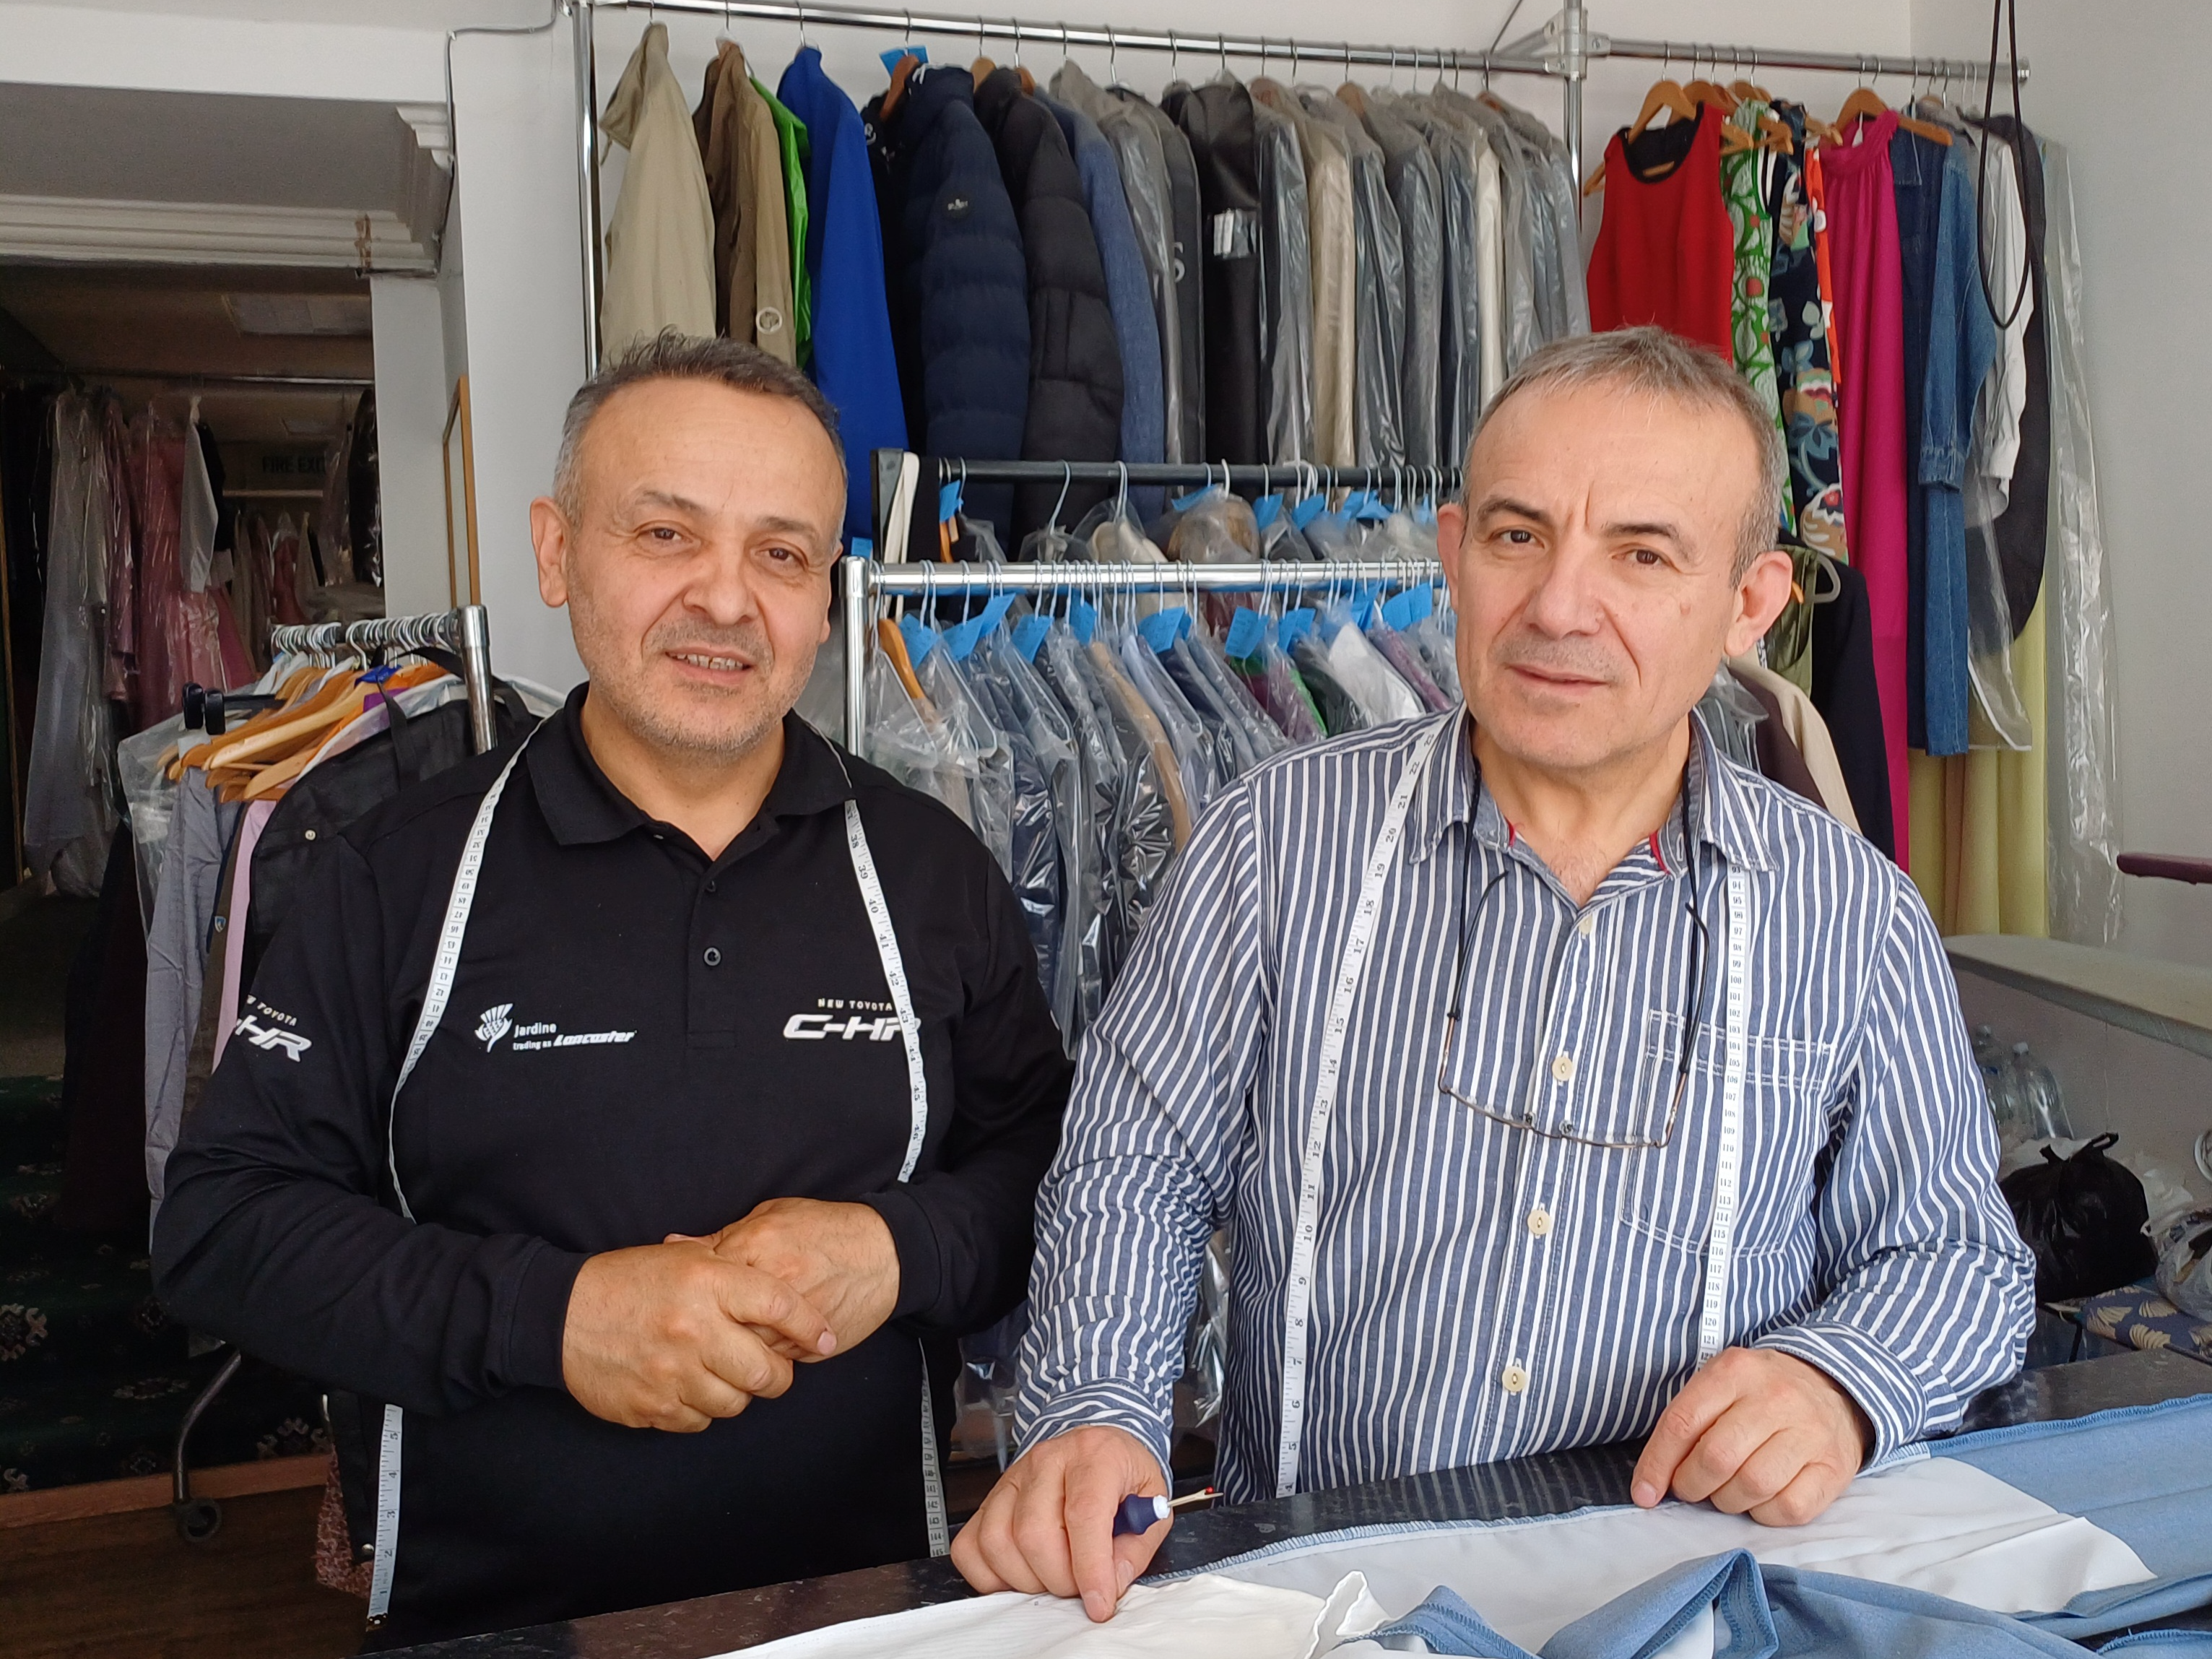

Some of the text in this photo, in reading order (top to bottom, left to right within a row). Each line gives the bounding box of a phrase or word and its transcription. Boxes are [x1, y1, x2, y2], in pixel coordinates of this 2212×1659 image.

[1397, 794, 1408, 810] 21
[1386, 828, 1397, 843] 20
[851, 834, 859, 849] 38
[858, 865, 869, 880] 39
[1374, 863, 1385, 878] 19
[1363, 899, 1374, 915] 18
[1353, 937, 1364, 954] 17
[1730, 974, 1742, 984] 100
[1344, 976, 1354, 994] 16
[1730, 992, 1740, 1001] 101
[817, 998, 893, 1011] NEW TOYOTA
[257, 1002, 297, 1026] TOYOTA
[1729, 1008, 1740, 1018] 102
[514, 1023, 557, 1038] Jardine
[1335, 1018, 1345, 1034] 15
[1729, 1025, 1740, 1034] 103
[513, 1041, 541, 1050] trading
[553, 1031, 636, 1047] Lancaster
[1328, 1059, 1337, 1075] 14
[1729, 1058, 1740, 1067] 105
[1727, 1075, 1738, 1083] 106
[1726, 1092, 1736, 1101] 107
[1319, 1099, 1328, 1116] 13
[1725, 1109, 1735, 1118] 108
[1724, 1126, 1735, 1135] 109
[1312, 1140, 1322, 1158] 12
[1723, 1143, 1733, 1152] 110
[1722, 1161, 1732, 1169] 111
[1720, 1178, 1732, 1187] 112
[1307, 1184, 1315, 1200] 11
[1719, 1195, 1731, 1205] 113
[1716, 1212, 1728, 1222] 114
[1304, 1224, 1313, 1242] 10
[1714, 1229, 1726, 1239] 115
[1712, 1247, 1724, 1256] 116
[1709, 1264, 1722, 1274] 117
[1708, 1281, 1719, 1291] 118
[1706, 1299, 1718, 1309] 119
[1295, 1318, 1304, 1327] 8
[1704, 1317, 1717, 1326] 120
[1704, 1335, 1715, 1345] 121
